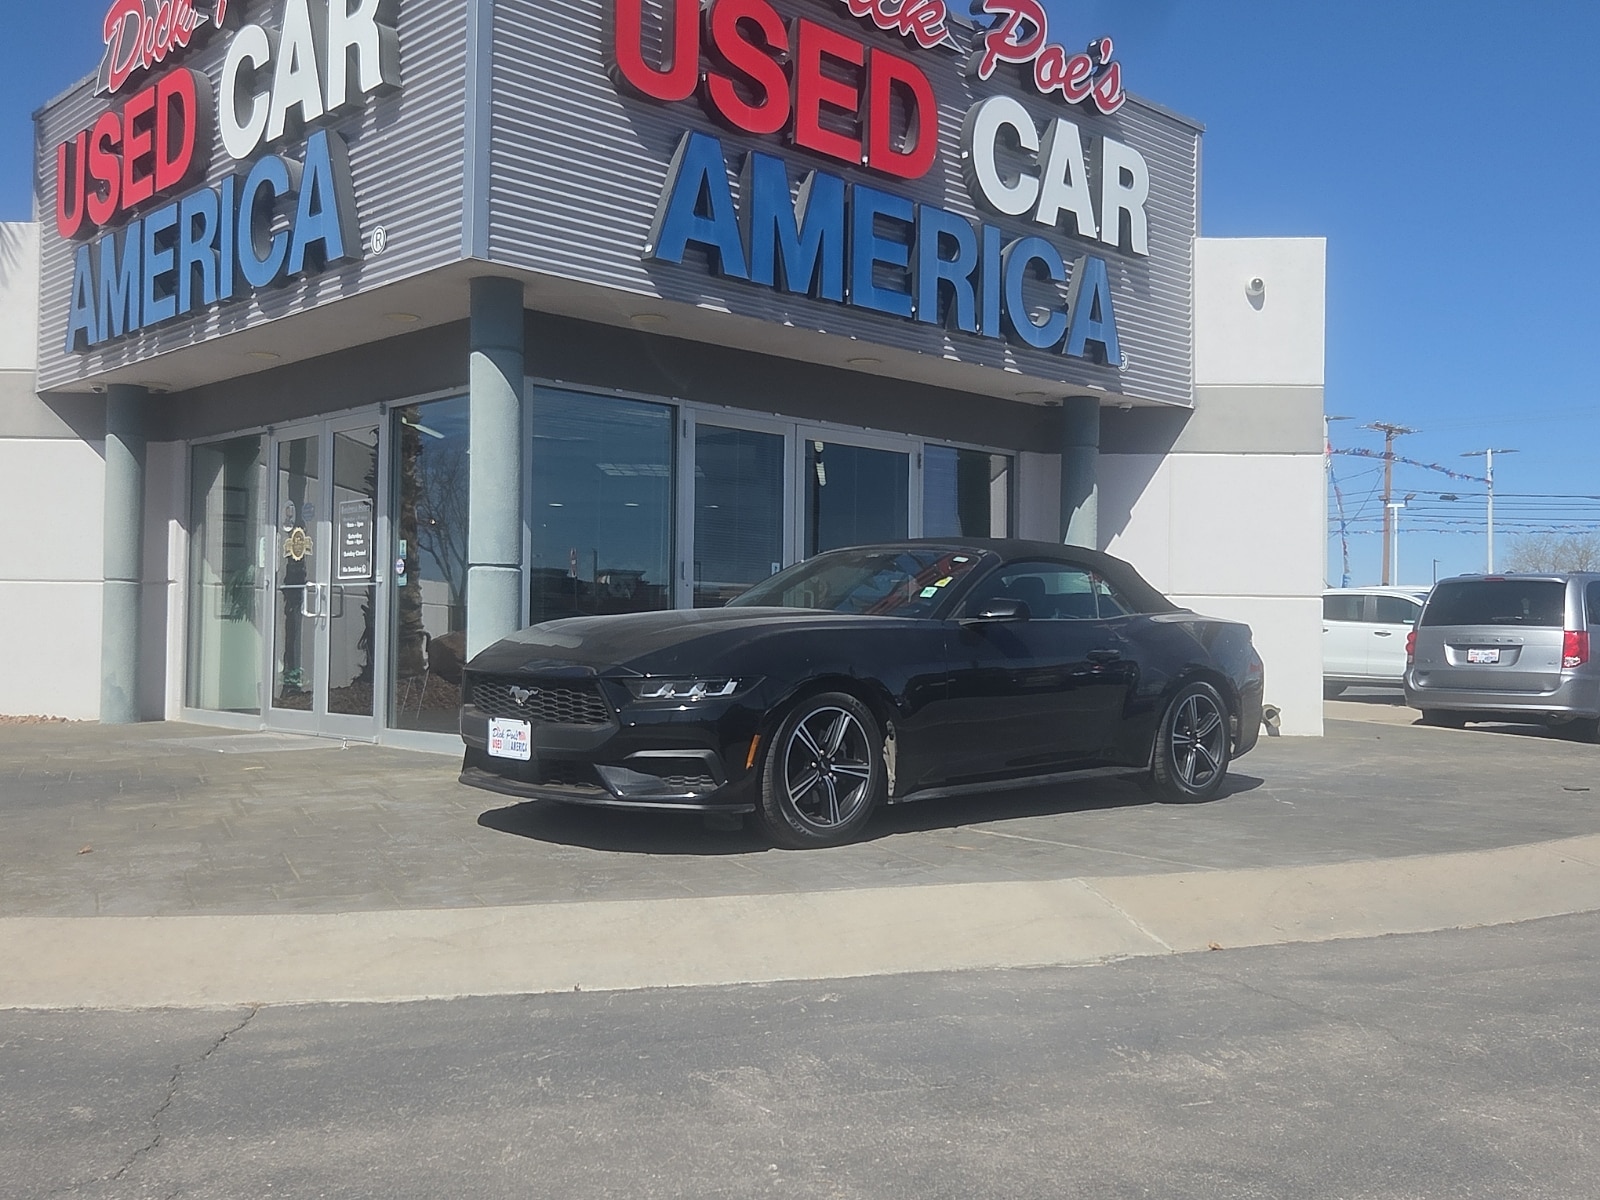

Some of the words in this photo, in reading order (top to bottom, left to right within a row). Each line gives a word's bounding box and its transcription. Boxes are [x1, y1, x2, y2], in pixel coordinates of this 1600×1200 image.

[56, 67, 197, 239] USED
[219, 0, 384, 160] CAR
[103, 0, 196, 93] Dick
[615, 0, 938, 180] USED
[972, 96, 1150, 257] CAR
[978, 0, 1126, 115] Poe's
[64, 130, 345, 354] AMERICA
[654, 130, 1121, 367] AMERICA
